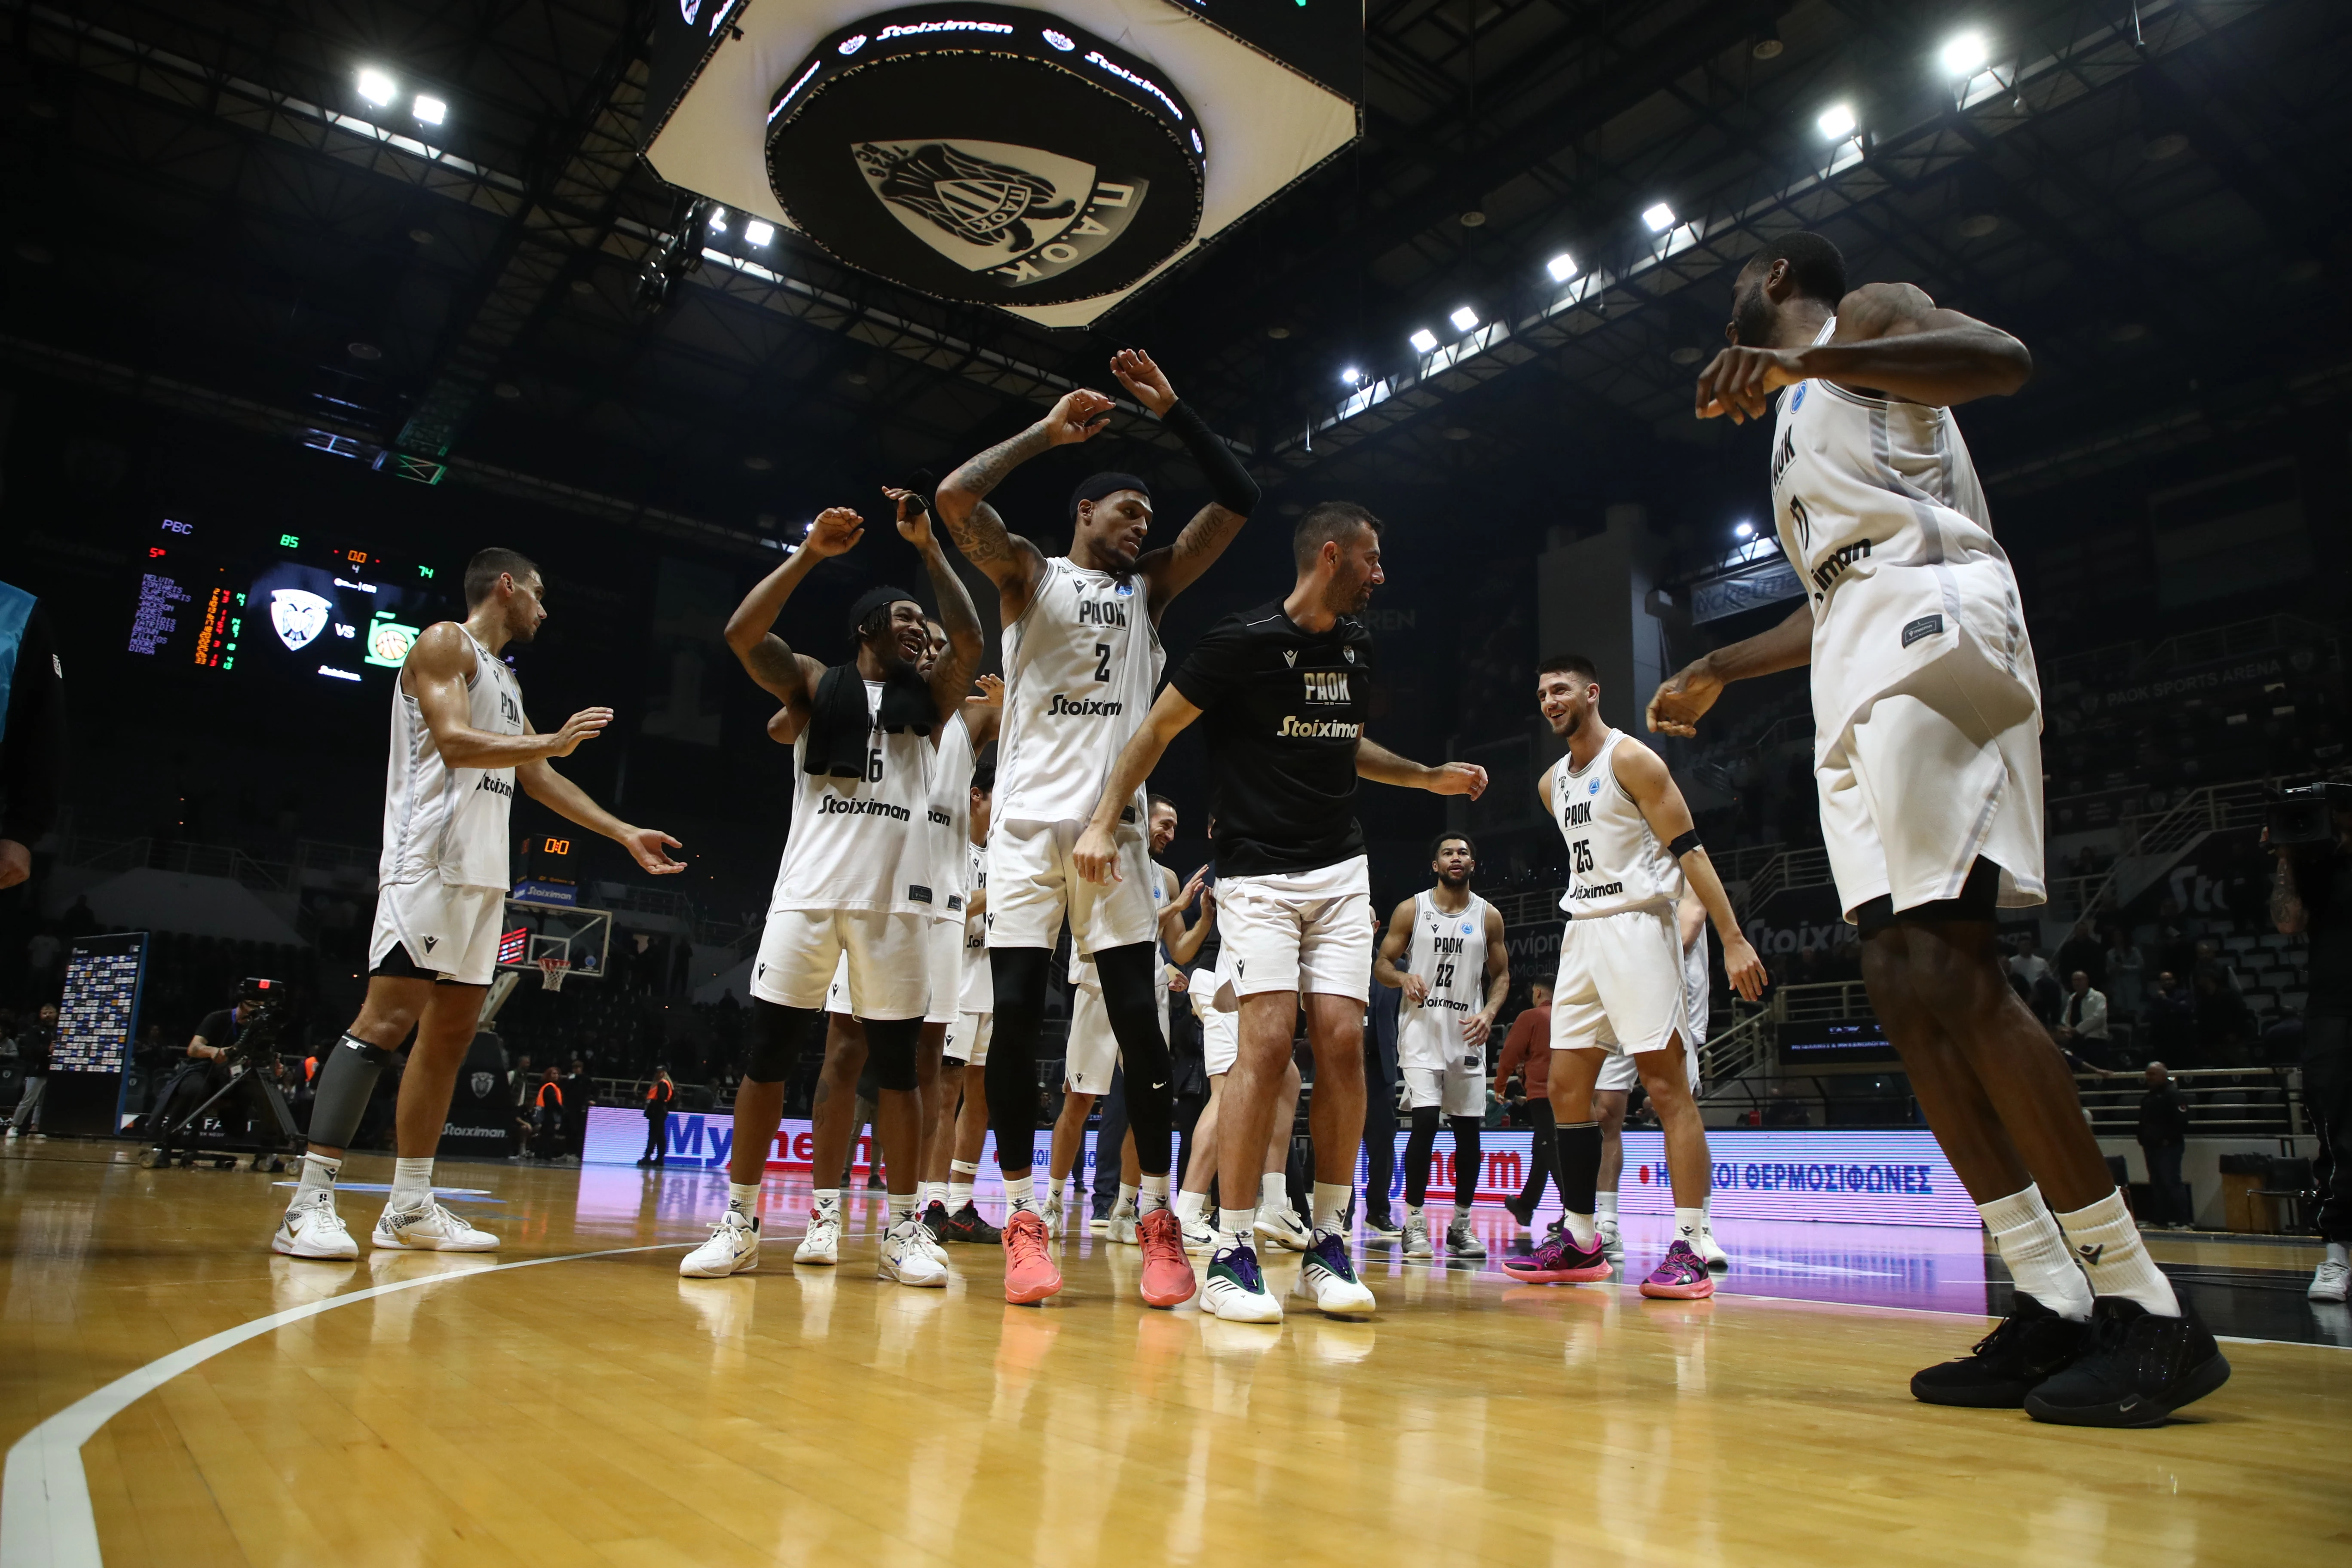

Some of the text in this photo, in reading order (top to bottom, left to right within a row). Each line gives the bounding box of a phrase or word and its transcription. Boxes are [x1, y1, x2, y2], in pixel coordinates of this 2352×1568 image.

[876, 20, 1014, 41] Stoiximan
[1084, 51, 1183, 120] Stoiximan
[161, 518, 193, 535] PBC
[280, 534, 300, 548] 85
[352, 564, 360, 574] 4
[418, 565, 434, 579] 74
[1079, 600, 1126, 627] PAOK
[1095, 643, 1110, 683] 2
[1304, 672, 1351, 701] PAOK
[2107, 659, 2282, 707] PAOK SPORTS ARENA
[818, 794, 910, 822] Stoiximan
[1565, 800, 1592, 828] PAOK
[1573, 839, 1594, 874] 25
[527, 886, 573, 900] Stoiximan
[1434, 937, 1464, 954] PAOK
[1436, 963, 1455, 988] 22
[1744, 1163, 1934, 1194] ΘΕΡΜΟΣΙΦΩΝΕΣ
